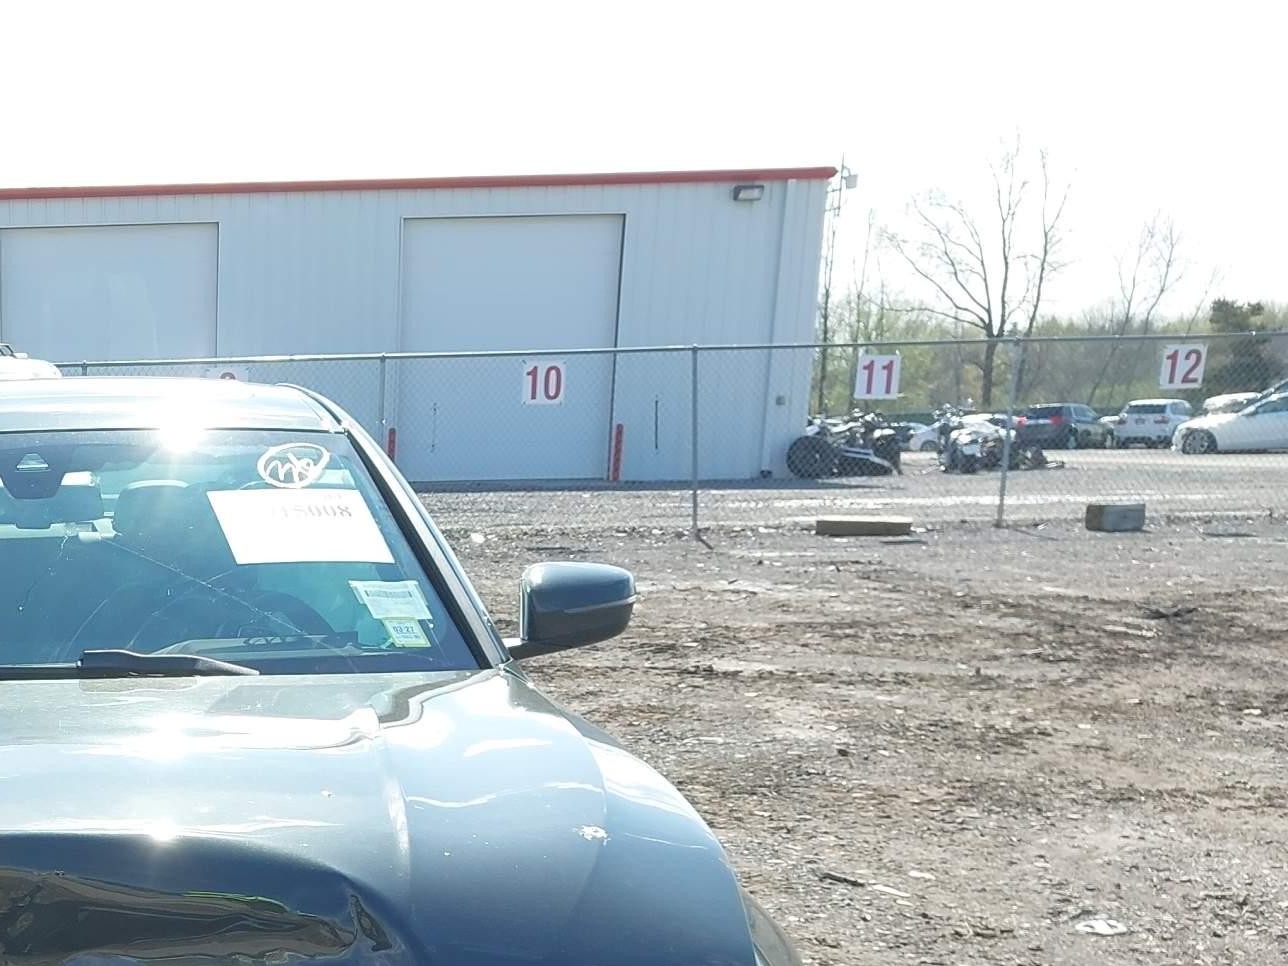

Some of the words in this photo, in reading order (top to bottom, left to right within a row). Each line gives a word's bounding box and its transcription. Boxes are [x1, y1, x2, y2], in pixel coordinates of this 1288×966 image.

[527, 366, 561, 398] 10
[862, 359, 895, 390] 11
[1167, 350, 1198, 385] 12
